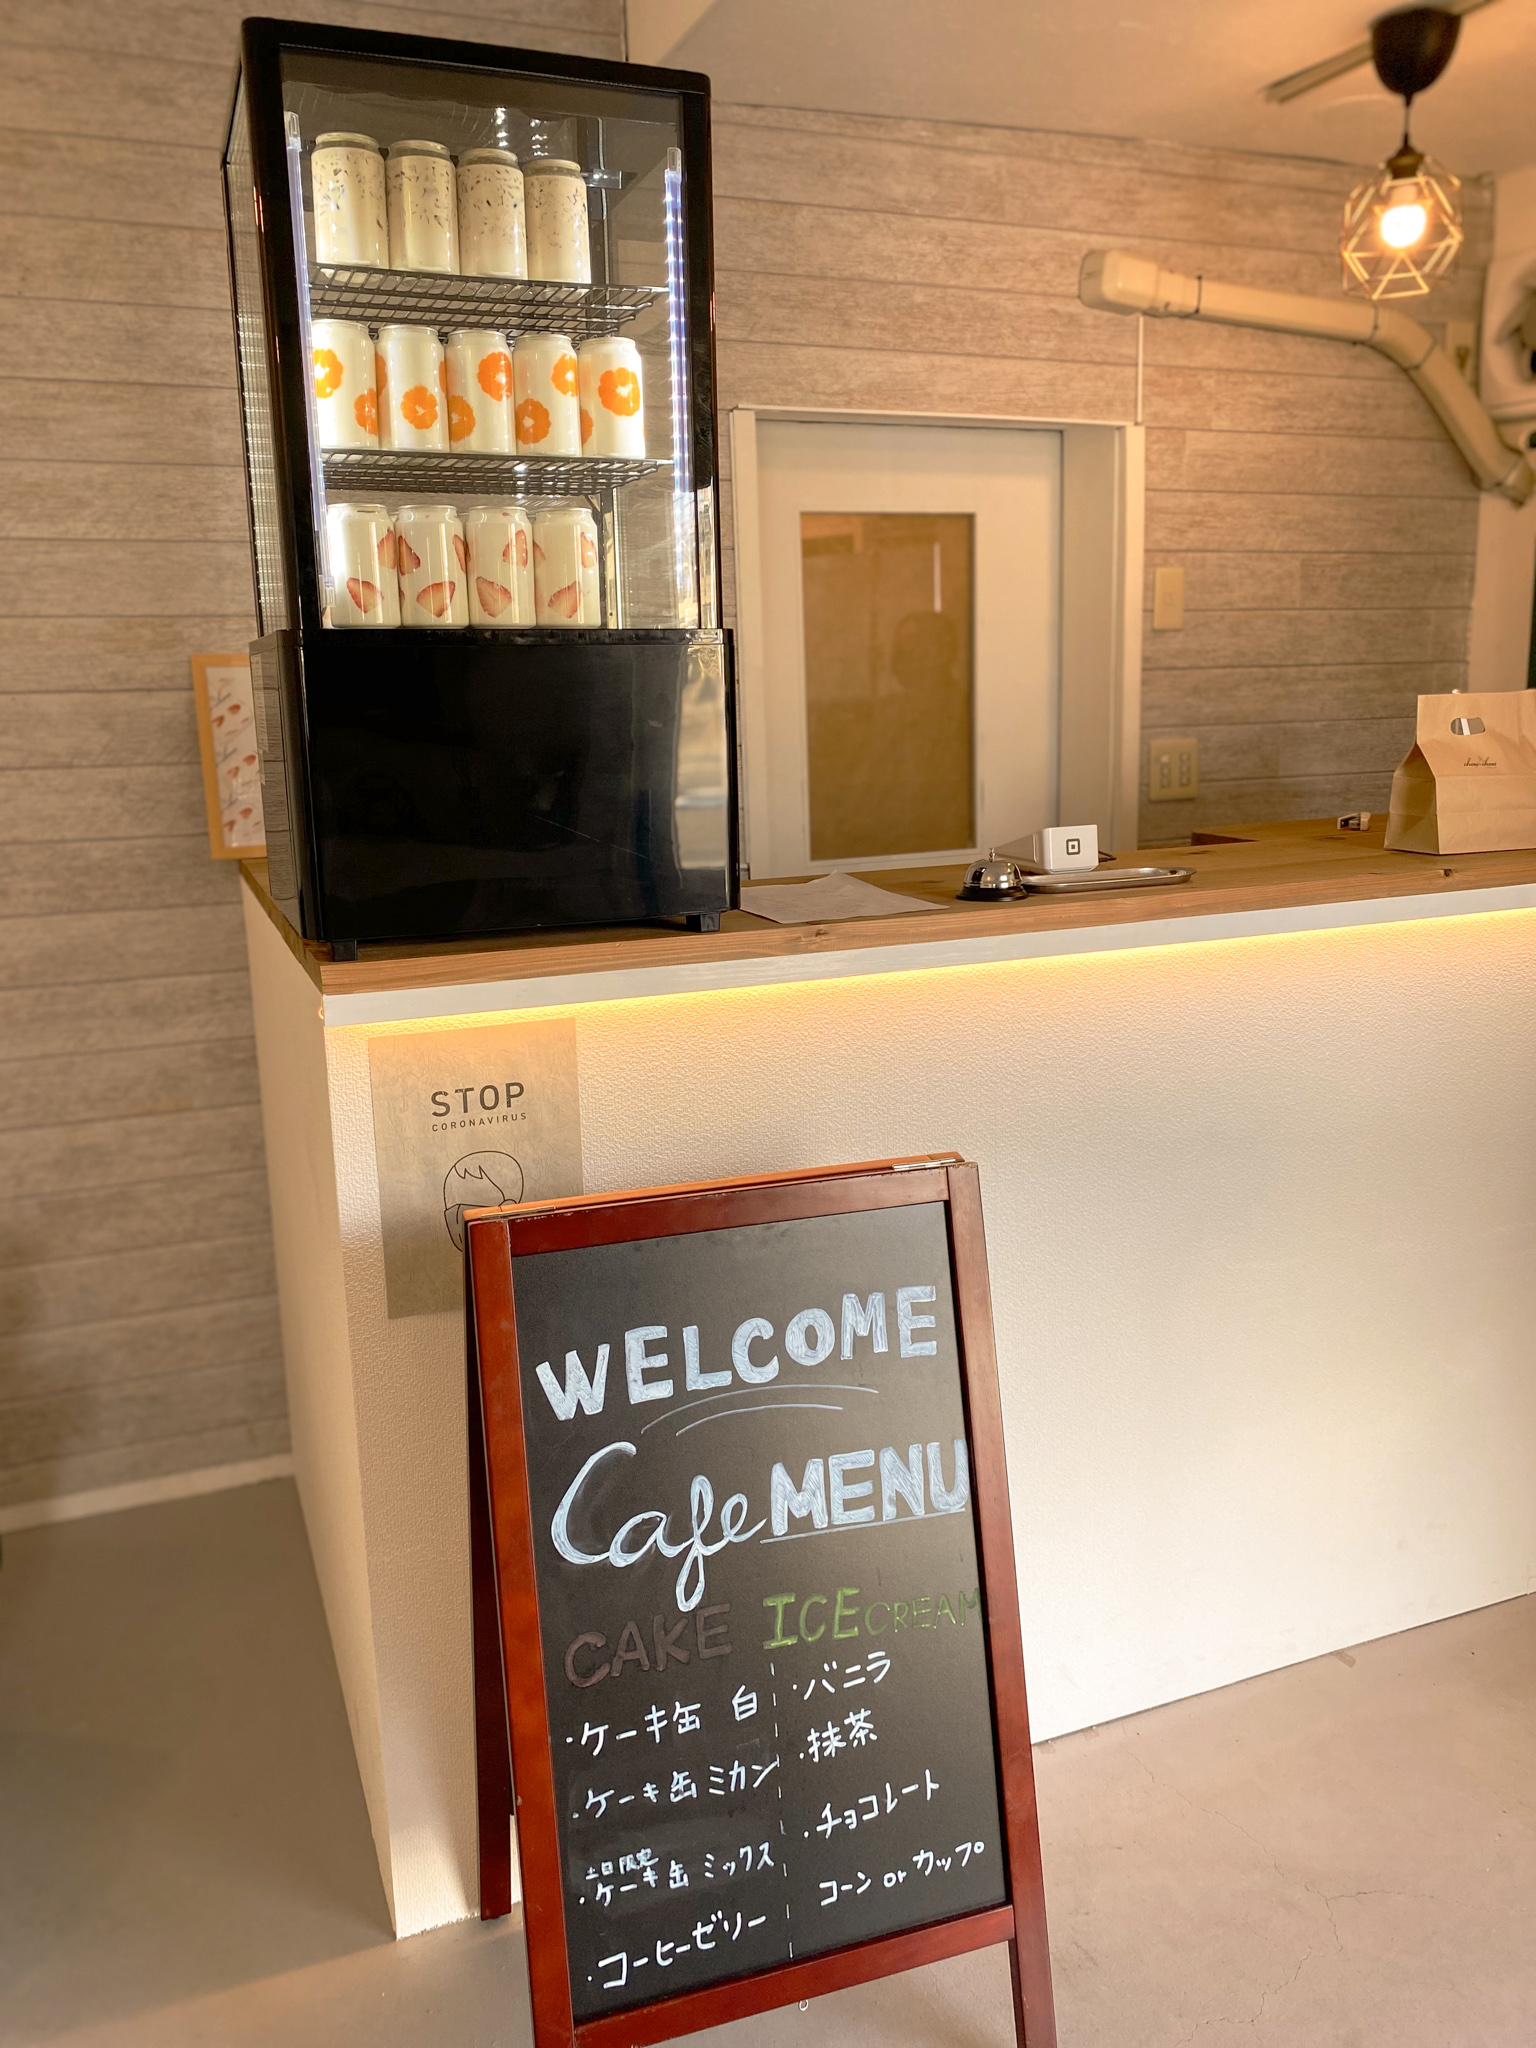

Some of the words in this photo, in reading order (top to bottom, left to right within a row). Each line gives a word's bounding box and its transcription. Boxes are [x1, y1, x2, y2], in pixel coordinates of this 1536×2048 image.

[430, 1081, 525, 1118] STOP
[431, 1112, 527, 1132] CORONAVIRUS
[535, 1285, 937, 1421] WELCOME
[550, 1441, 768, 1612] Cafe
[770, 1439, 968, 1536] MENU
[564, 1603, 734, 1688] CAKE
[732, 1684, 758, 1722] 白
[803, 1651, 891, 1701] バニラ
[807, 1708, 878, 1763] 抹茶
[708, 1759, 780, 1796] ミカン
[815, 1768, 940, 1839] チョコレート
[704, 1841, 775, 1879] ミックス
[818, 1870, 872, 1907] コーン
[883, 1869, 907, 1888] or
[912, 1841, 985, 1876] カップ
[597, 1909, 767, 1990] コーヒーゼリー
